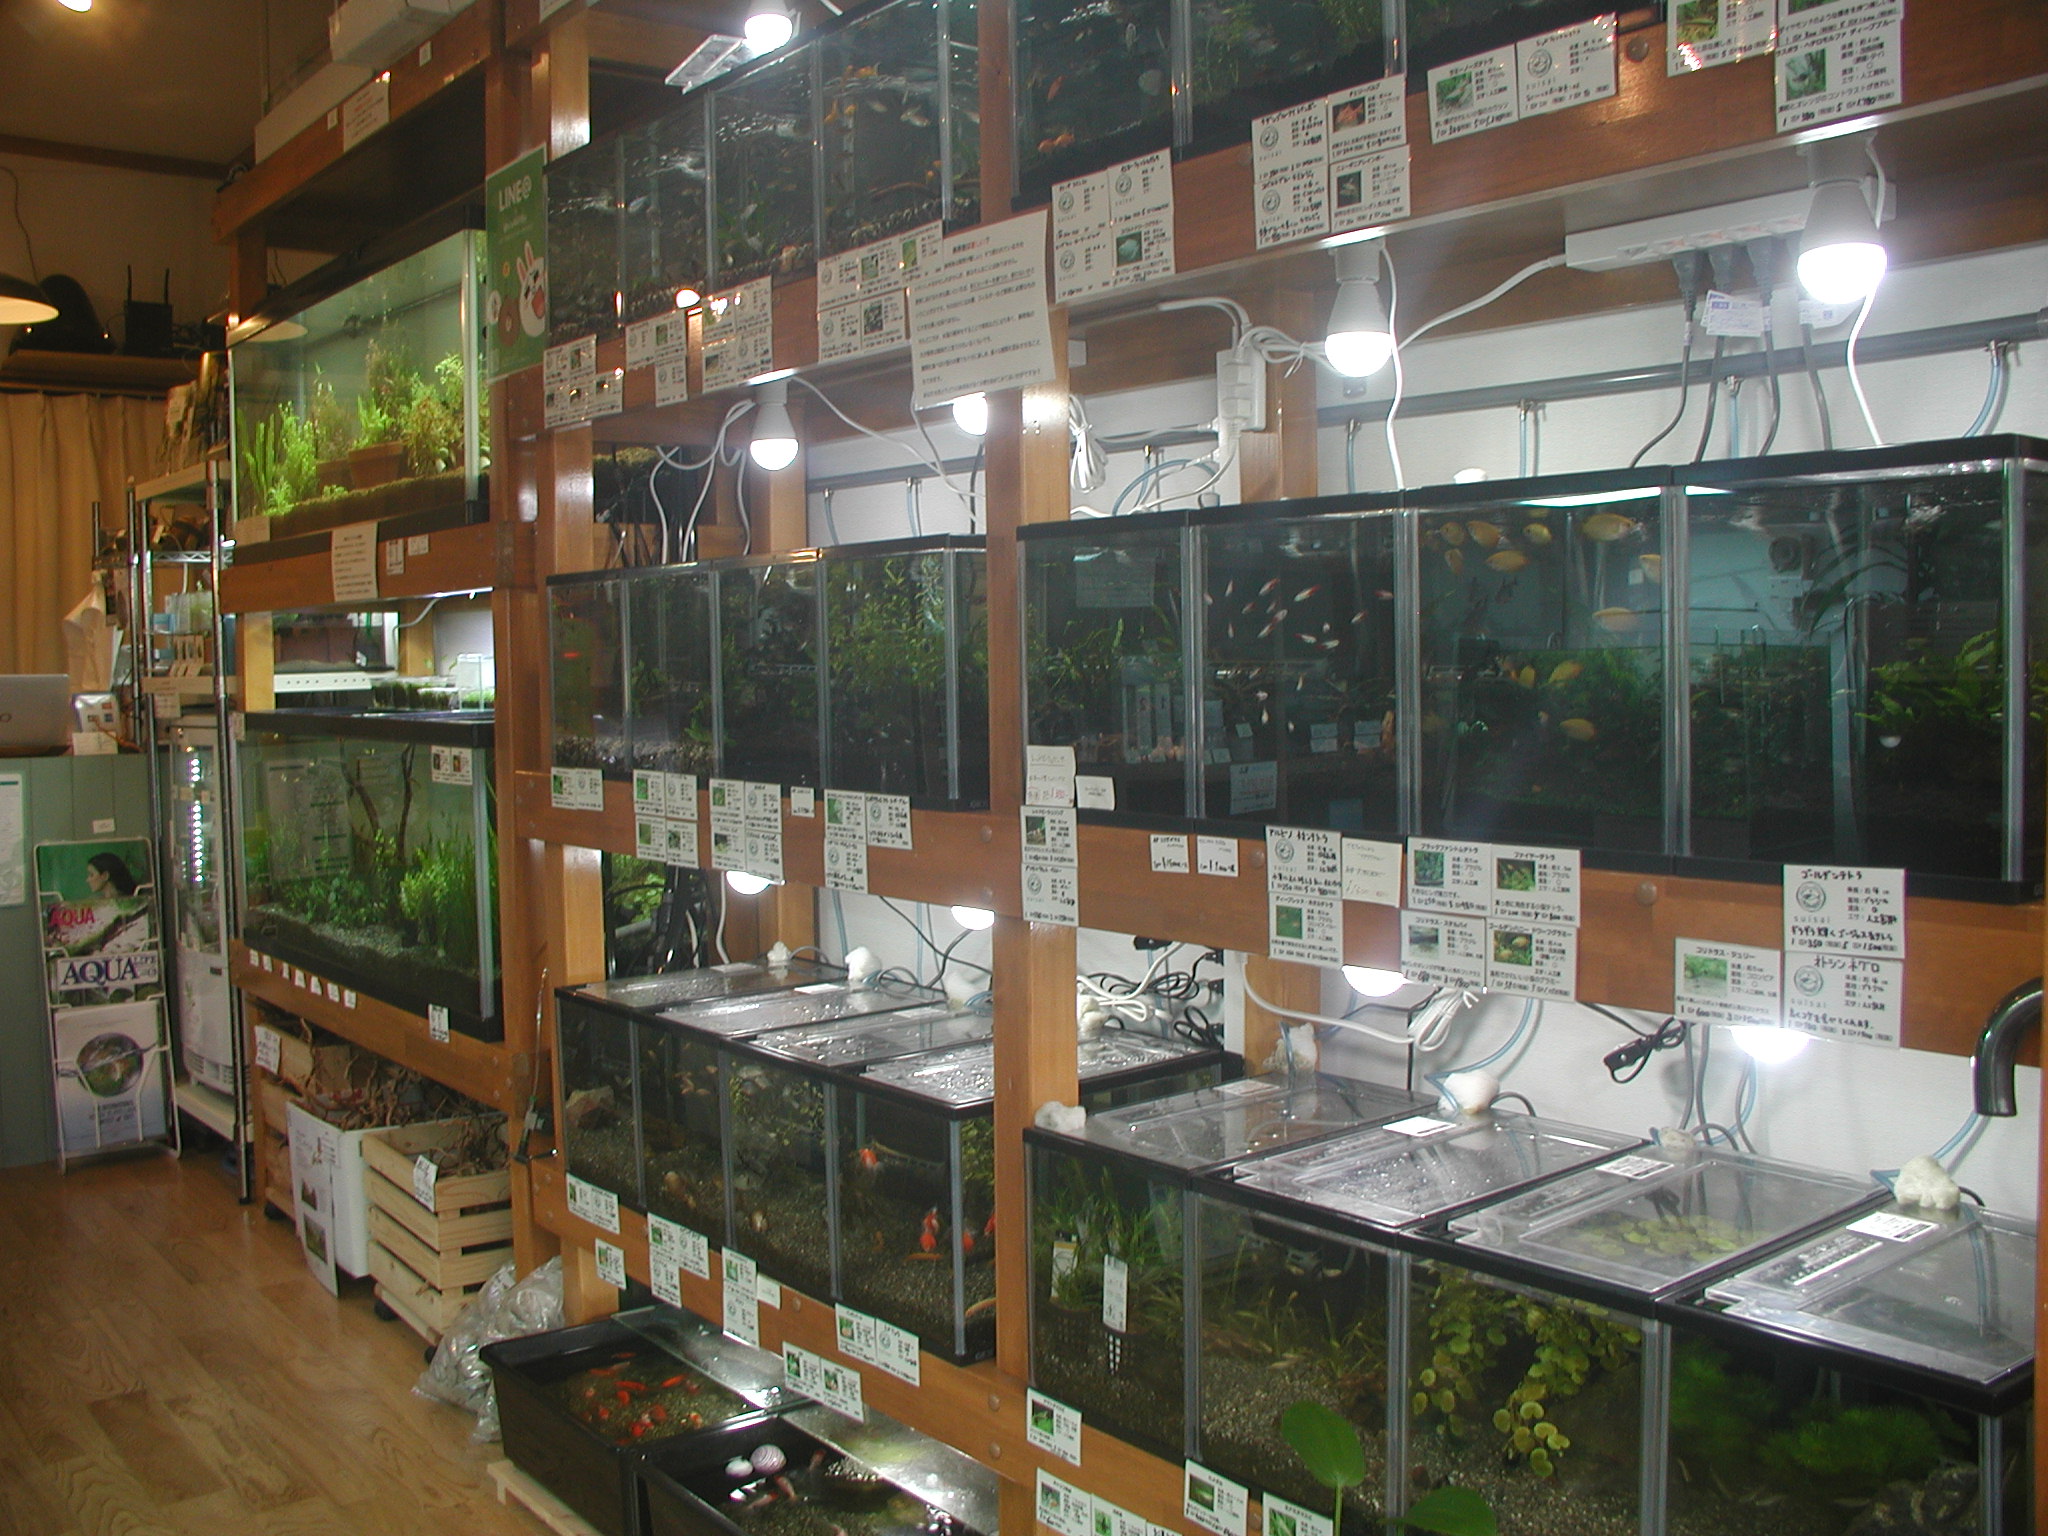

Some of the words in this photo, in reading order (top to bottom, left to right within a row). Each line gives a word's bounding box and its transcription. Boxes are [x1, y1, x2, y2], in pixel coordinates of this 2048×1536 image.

[499, 175, 532, 213] LINE@
[49, 904, 95, 928] AQUA
[60, 955, 139, 986] AQUA
